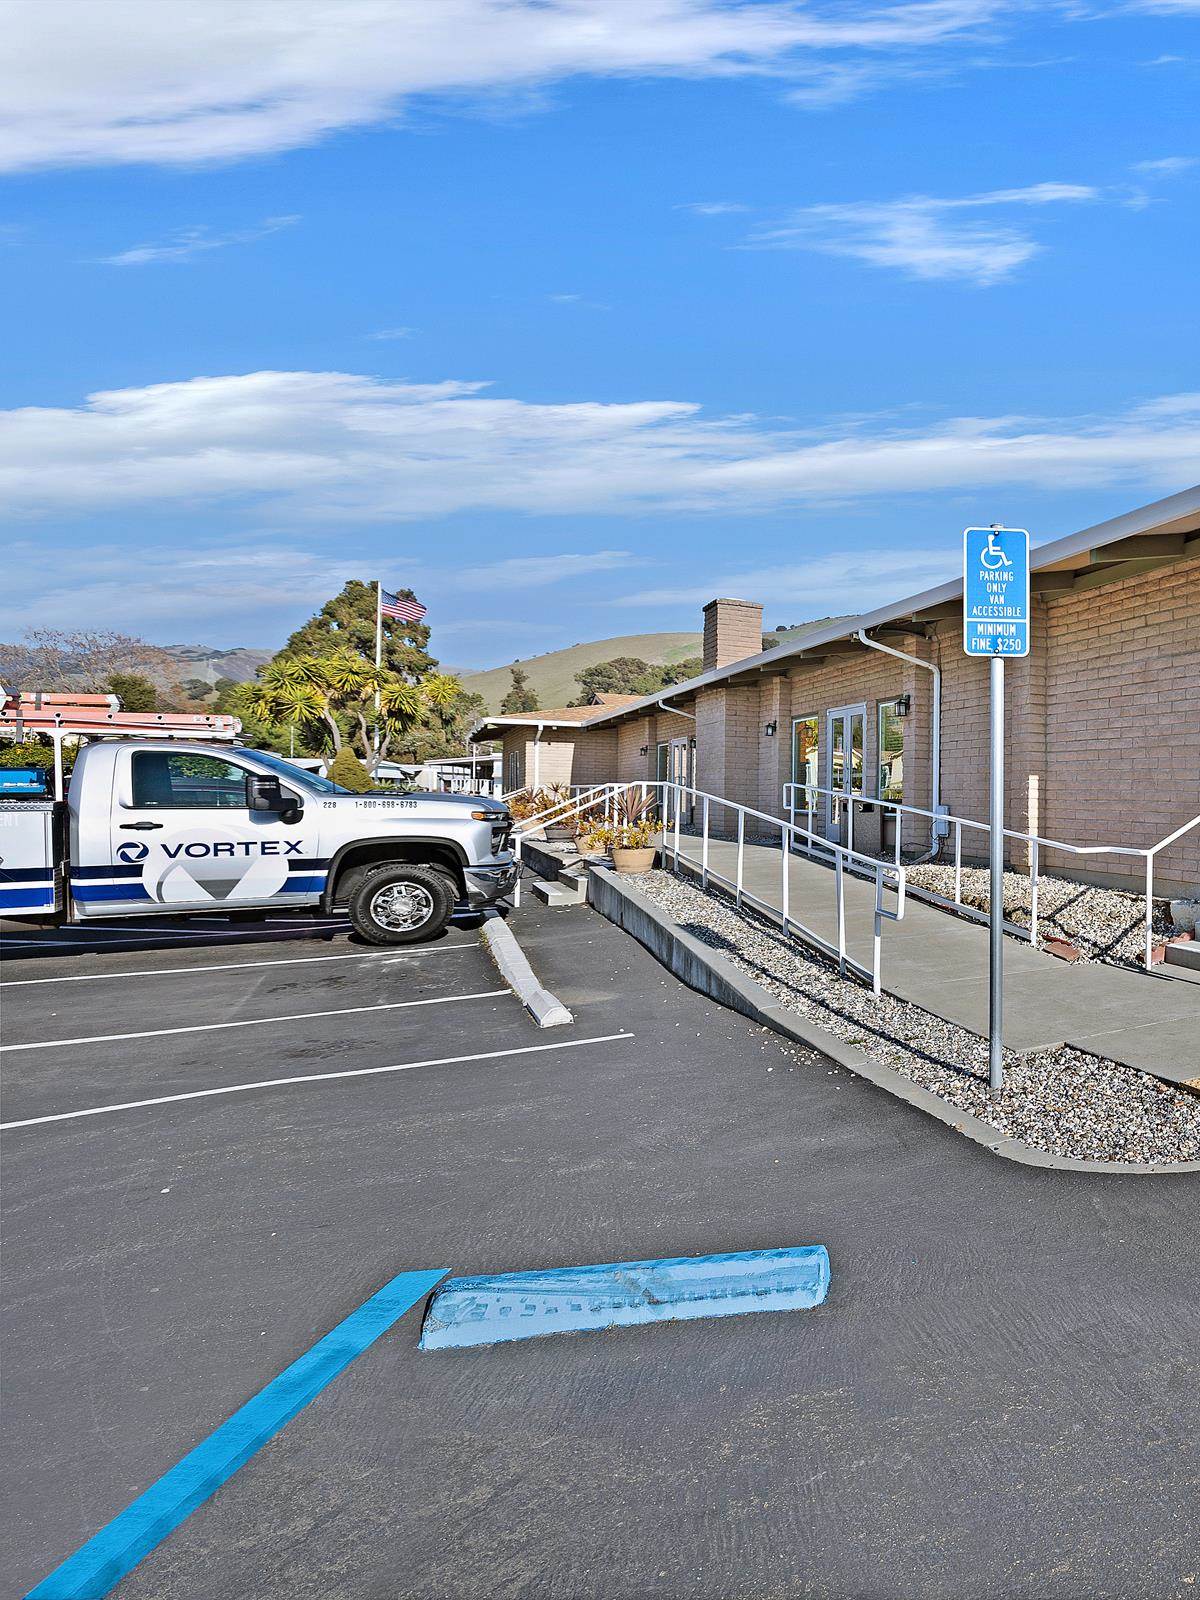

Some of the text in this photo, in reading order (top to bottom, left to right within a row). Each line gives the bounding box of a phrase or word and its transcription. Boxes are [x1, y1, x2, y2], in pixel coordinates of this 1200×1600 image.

[980, 571, 1014, 581] PARKING
[987, 582, 1007, 593] ONLY
[990, 594, 1005, 604] VAN
[972, 606, 1021, 616] ACCESSIBLE
[977, 623, 1016, 635] MINIMUM
[971, 637, 1021, 651] FINE $250
[160, 840, 304, 859] VORTEX
